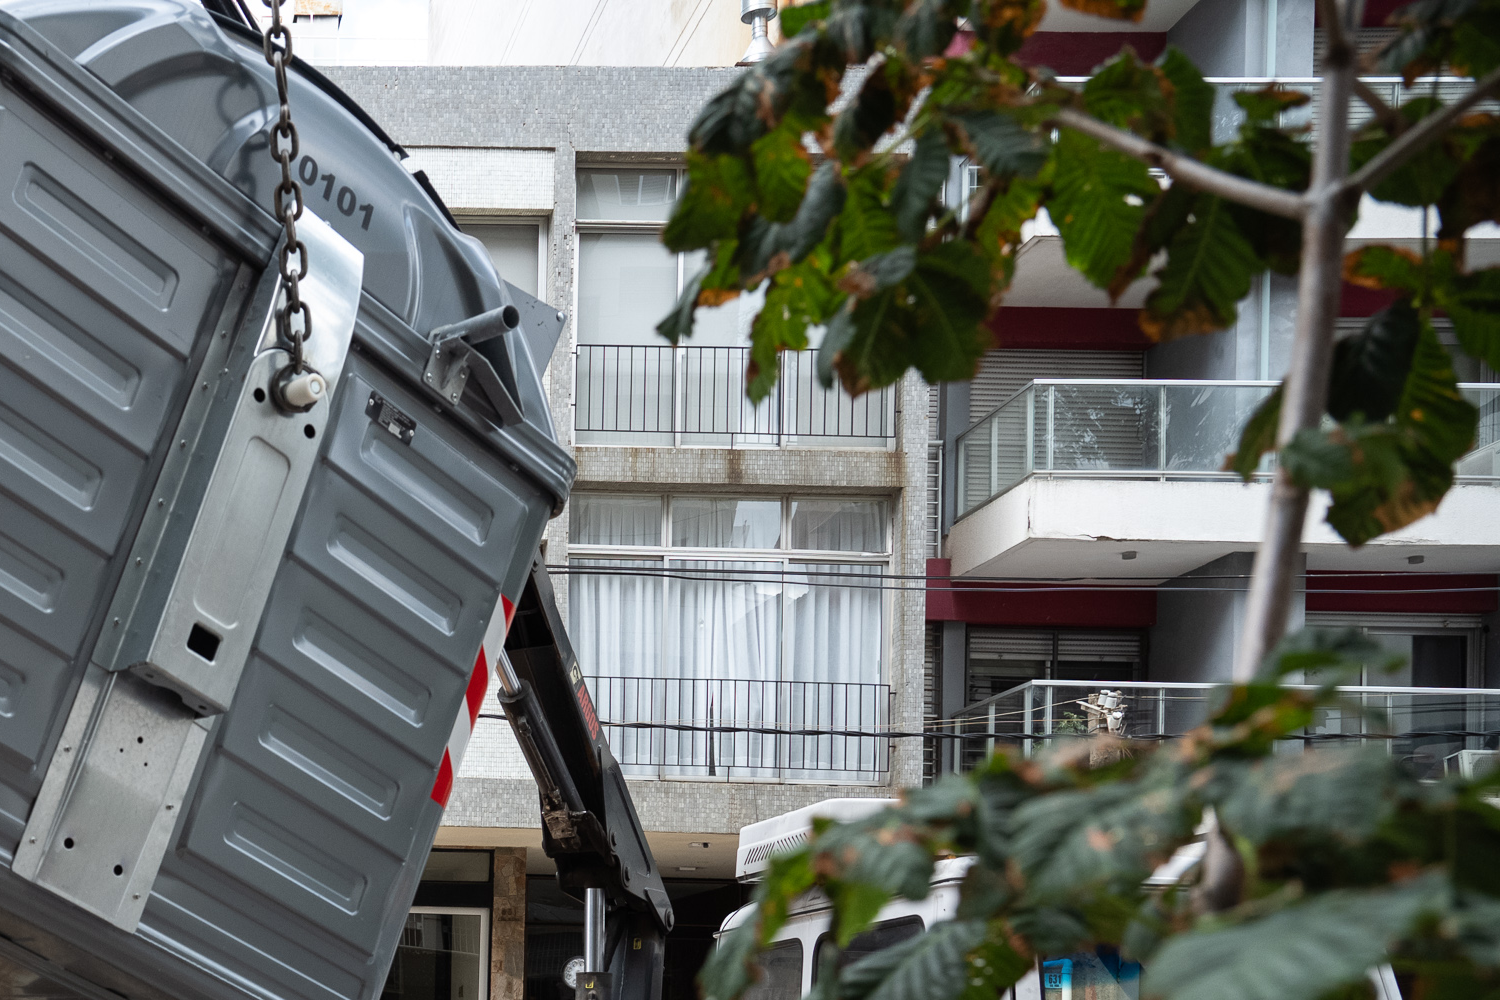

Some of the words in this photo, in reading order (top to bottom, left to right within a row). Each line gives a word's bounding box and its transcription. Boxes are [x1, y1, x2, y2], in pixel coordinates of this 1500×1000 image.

[299, 155, 374, 231] 0101
[577, 684, 599, 741] ARGOS
[1048, 974, 1062, 985] 631
